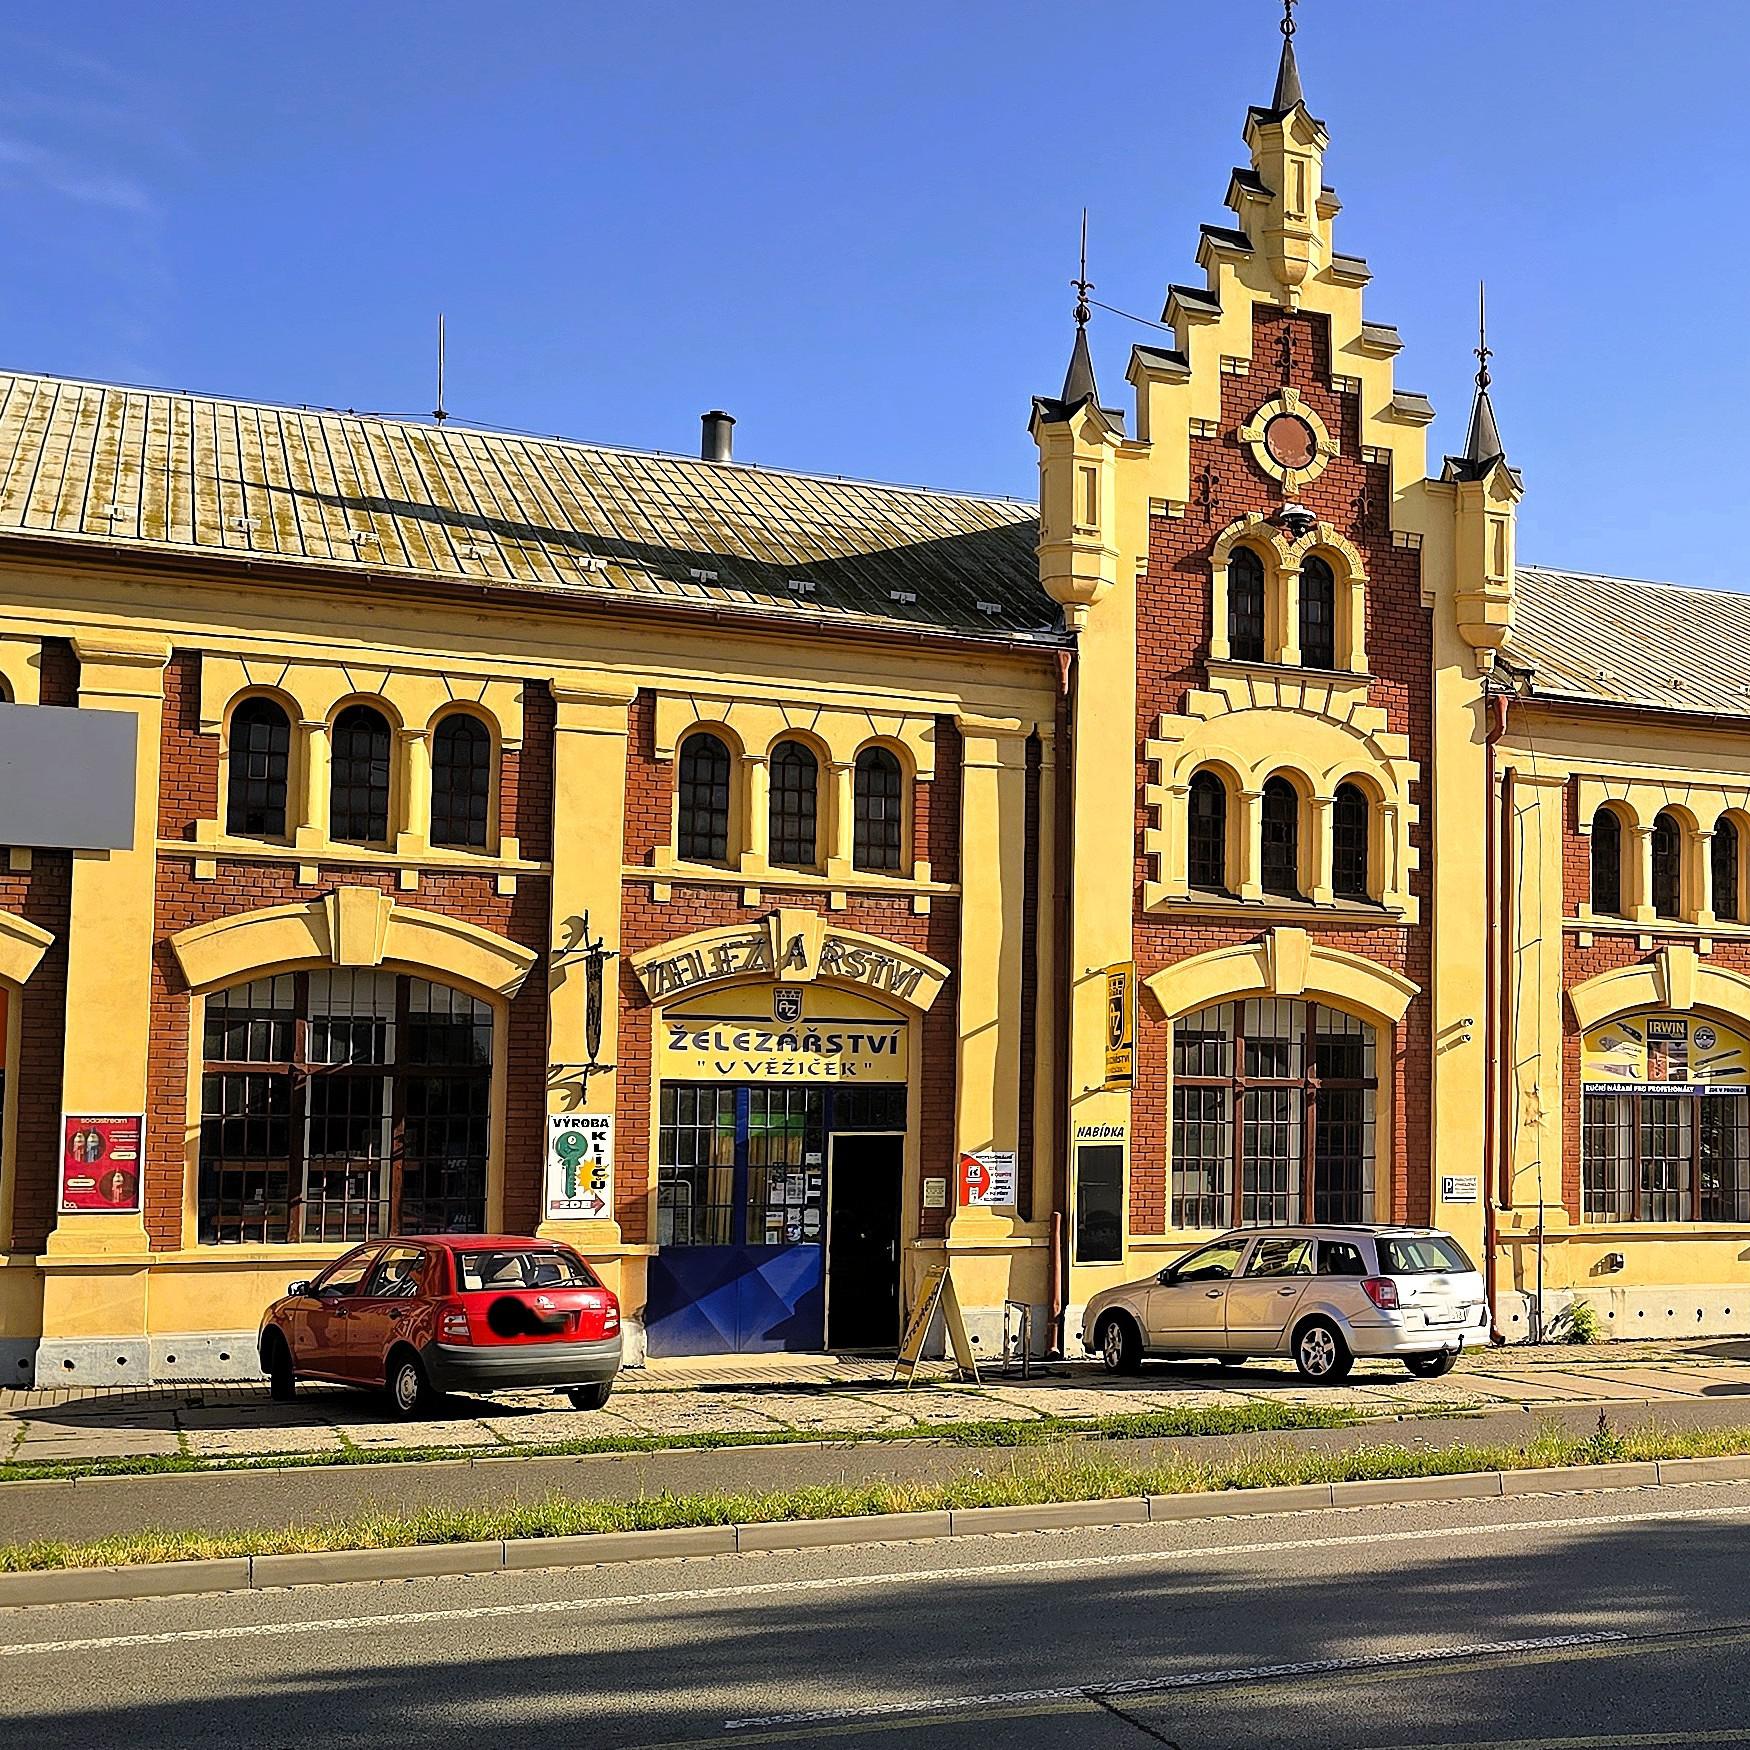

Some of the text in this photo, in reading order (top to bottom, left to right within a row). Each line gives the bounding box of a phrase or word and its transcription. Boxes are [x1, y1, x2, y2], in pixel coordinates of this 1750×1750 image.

[1649, 1021, 1686, 1034] IRWIN
[668, 1024, 900, 1054] ŽELEZÁŘSTVÍ
[743, 1058, 858, 1076] VĚŽIČEK
[1585, 1083, 1607, 1092] RUČNÍ
[1607, 1083, 1633, 1092] NÁŘADÍ
[1633, 1084, 1647, 1093] PRO
[553, 1115, 610, 1128] VÝROBA
[1076, 1122, 1125, 1138] NABÍDKA
